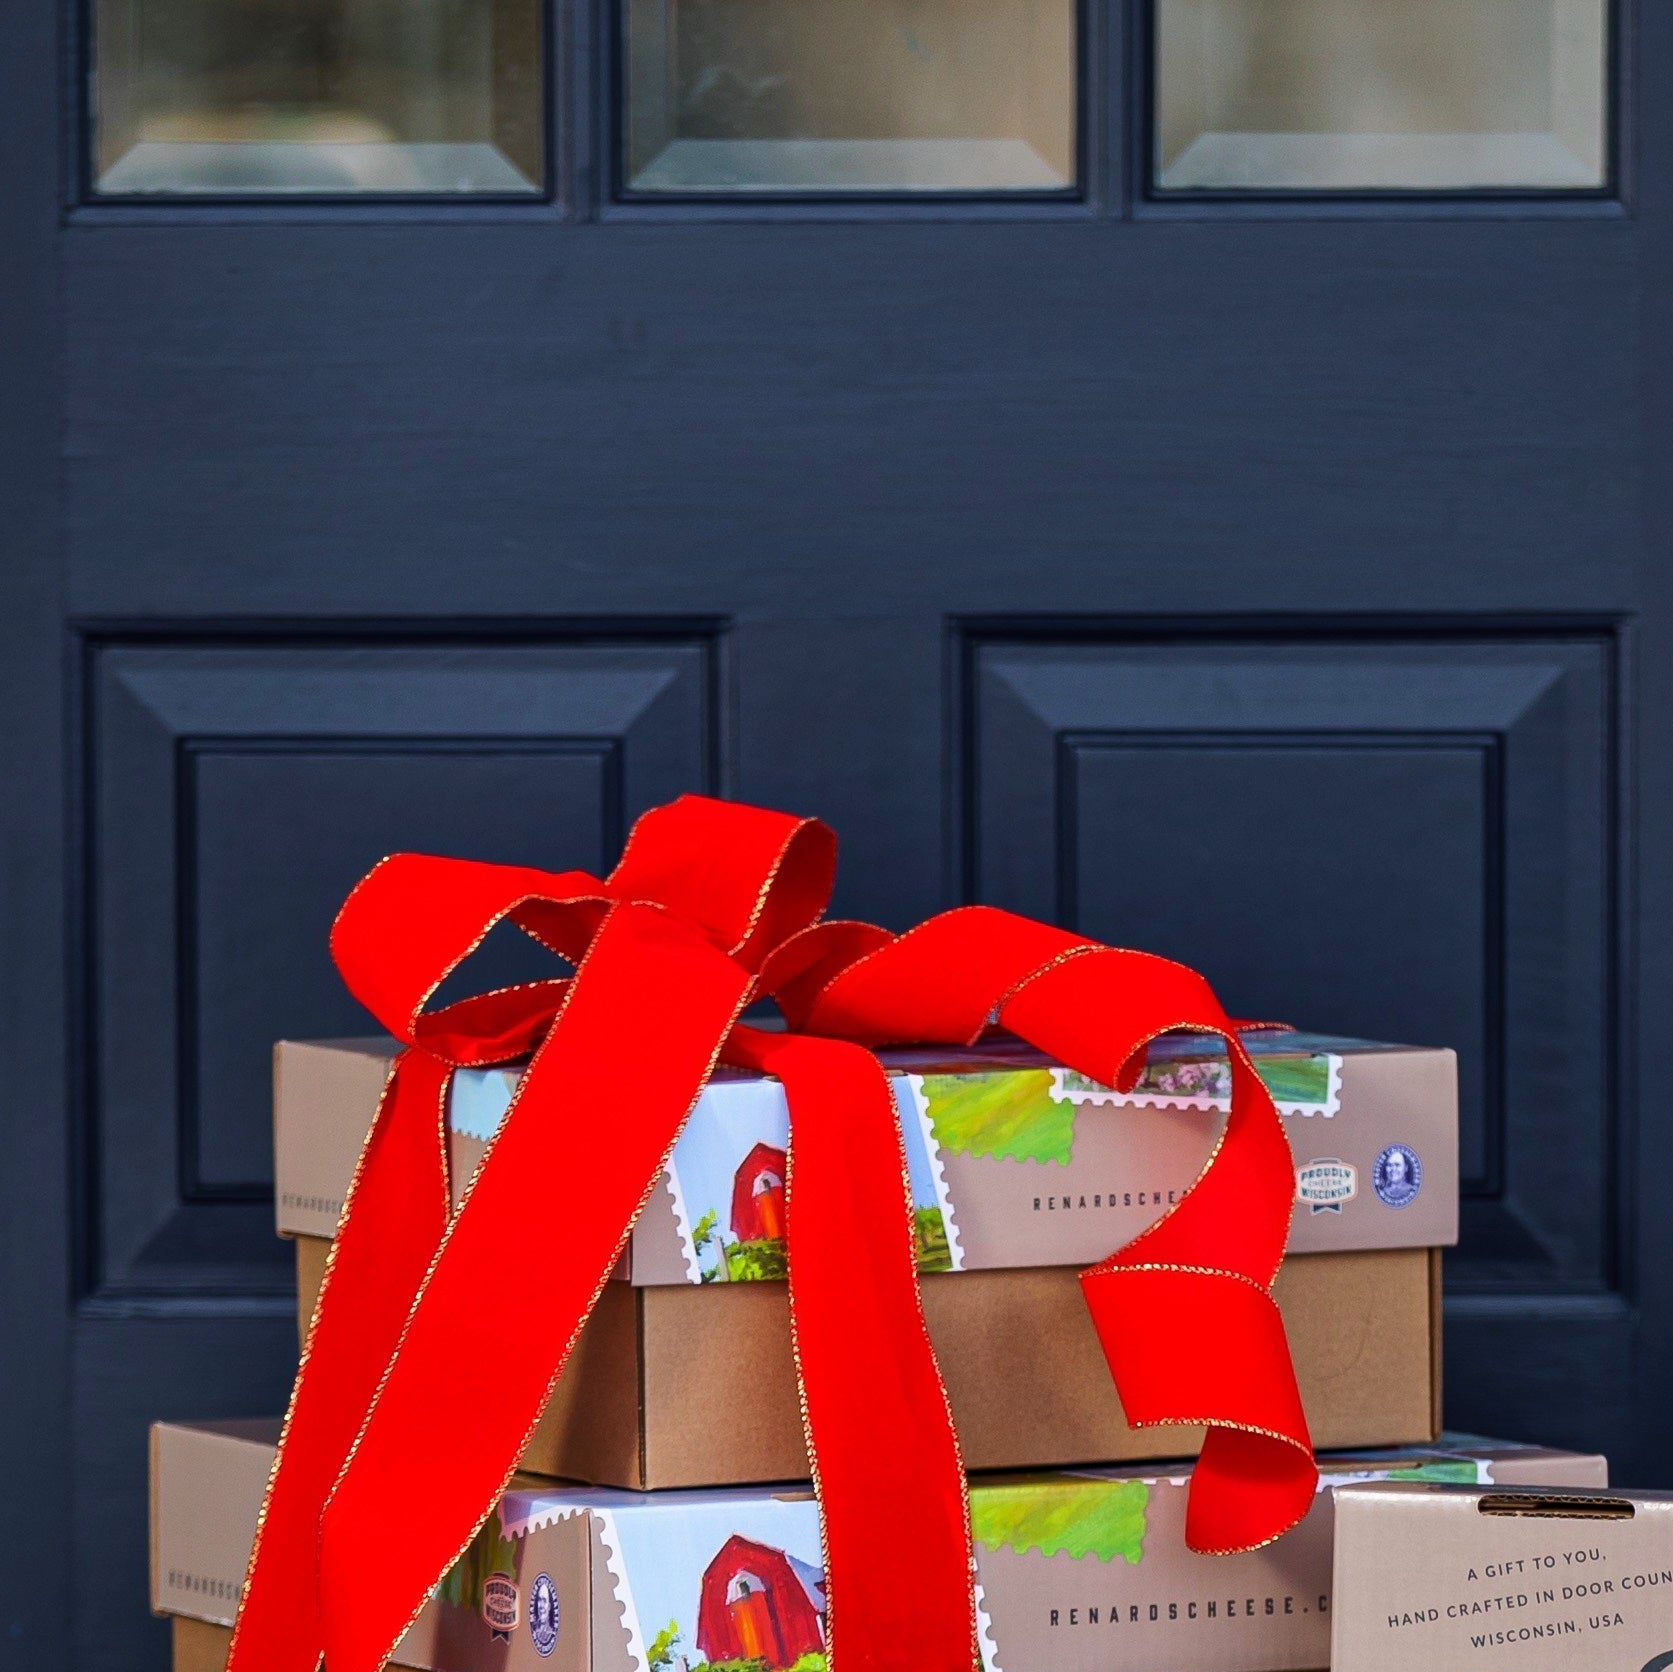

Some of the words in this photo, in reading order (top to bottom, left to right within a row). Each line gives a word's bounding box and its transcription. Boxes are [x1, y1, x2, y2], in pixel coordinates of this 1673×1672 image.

[1033, 1190, 1188, 1211] RENARDSCHE
[1467, 1568, 1478, 1581] A
[1485, 1560, 1525, 1578] GIFT
[1532, 1555, 1556, 1570] TO
[1563, 1548, 1607, 1564] YOU,
[1388, 1608, 1439, 1628] HAND
[1446, 1594, 1529, 1619] CRAFTED
[1535, 1589, 1555, 1604] IN
[1562, 1580, 1615, 1600] DOOR
[1470, 1620, 1583, 1648] WISCONSIN,
[1589, 1612, 1624, 1630] USA
